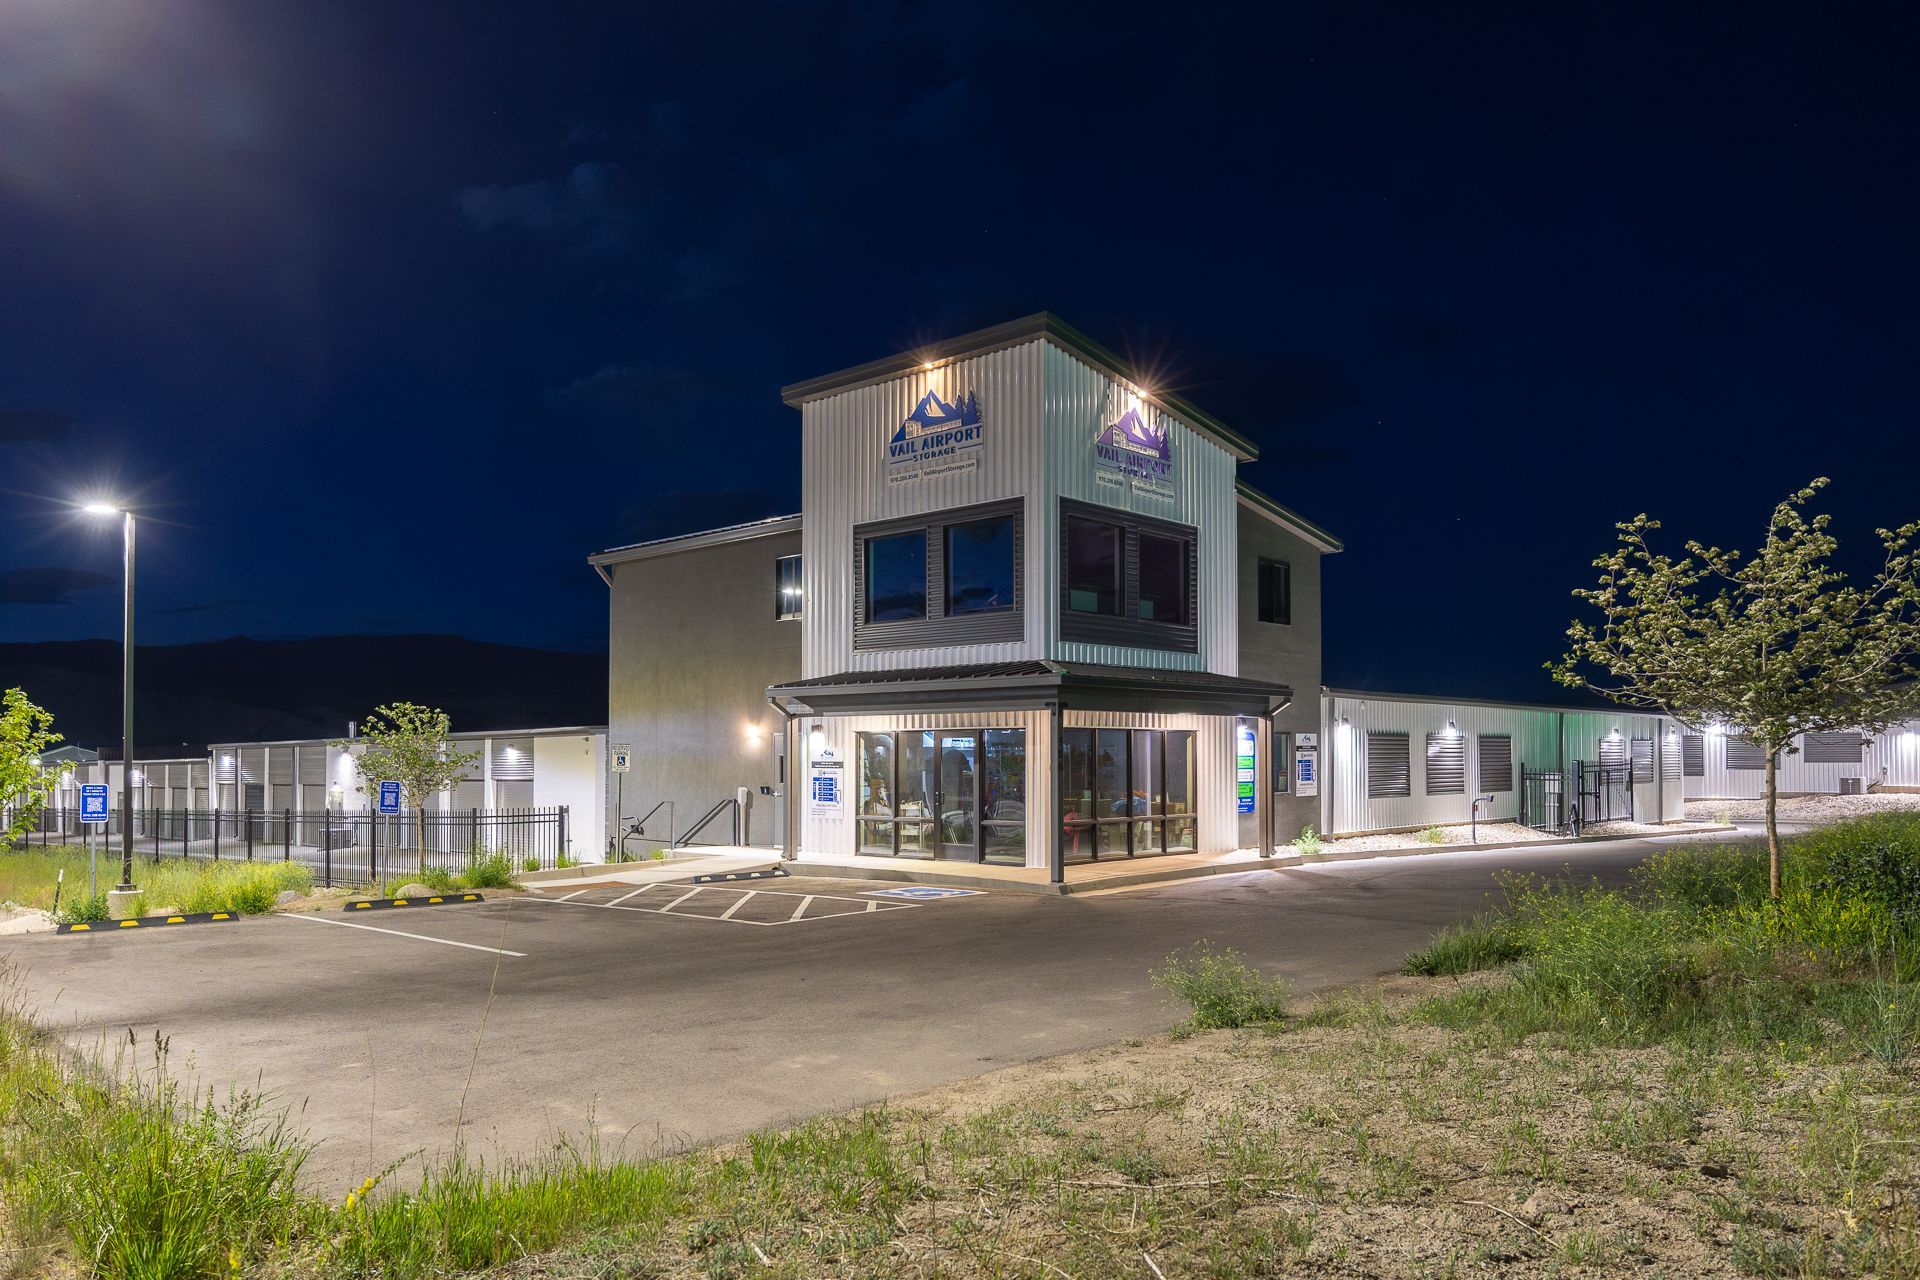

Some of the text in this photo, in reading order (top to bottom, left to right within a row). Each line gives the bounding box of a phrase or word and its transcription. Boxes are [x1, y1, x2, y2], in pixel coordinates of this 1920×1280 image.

[889, 425, 983, 458] VAIL AIRPORT
[913, 446, 957, 462] STORAGE
[1096, 444, 1173, 476] VAIL AIRPORT
[924, 462, 976, 476] VailAirportStorage.com
[1117, 465, 1155, 480] STORAGE
